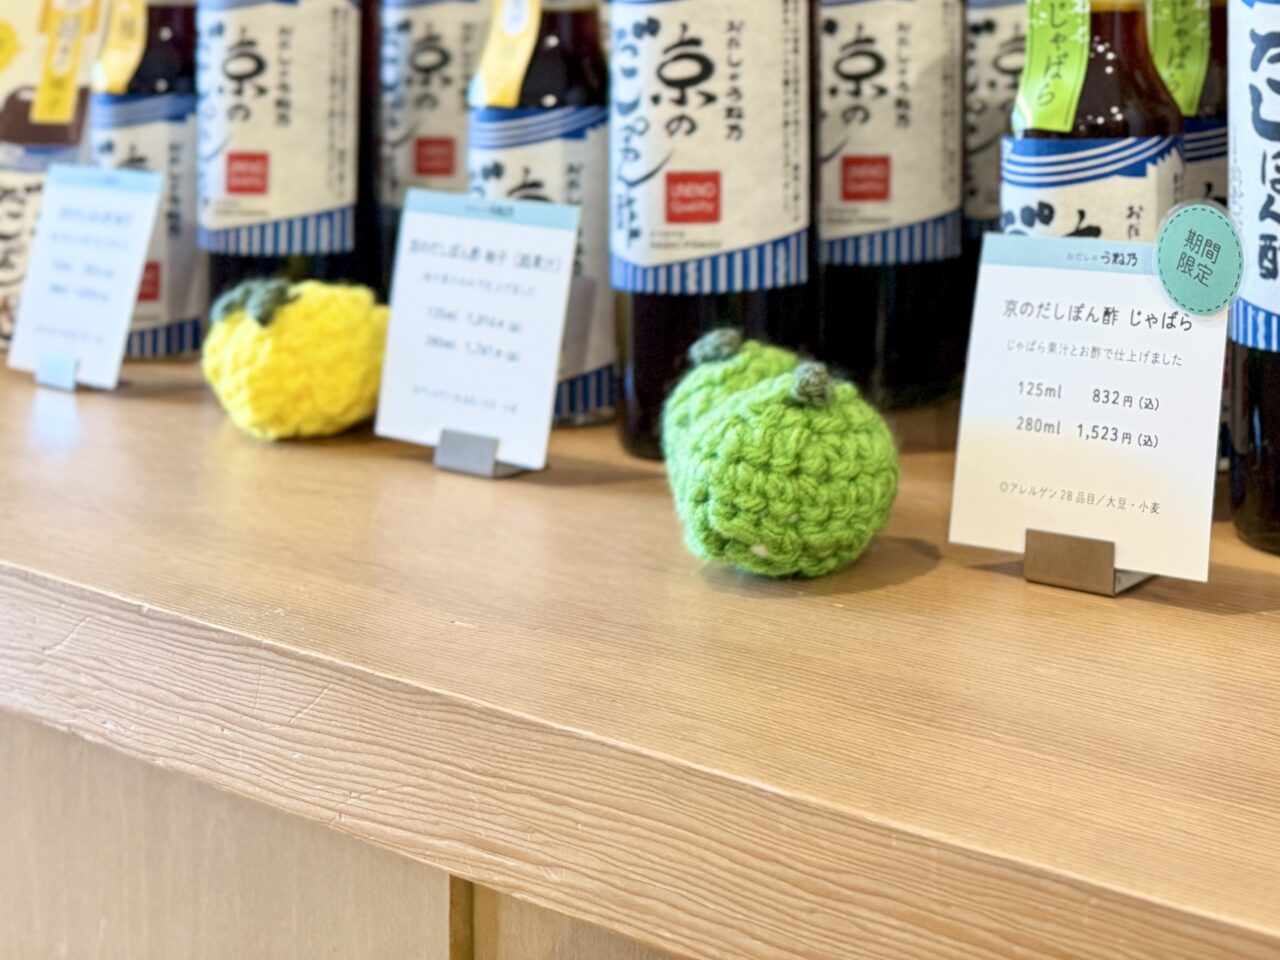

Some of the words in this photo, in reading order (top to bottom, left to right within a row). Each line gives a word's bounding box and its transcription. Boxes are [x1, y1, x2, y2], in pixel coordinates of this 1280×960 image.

[1038, 0, 1068, 106] じゃばら
[1183, 228, 1222, 265] 期間
[1176, 251, 1214, 289] 限定
[1002, 298, 1119, 326] 京のだしぽん酢
[1129, 308, 1193, 331] じゃばら
[1006, 339, 1183, 367] じゃばら果汁とお酢で仕上げました
[1017, 380, 1062, 399] 125ml
[1016, 415, 1061, 435] 280ml
